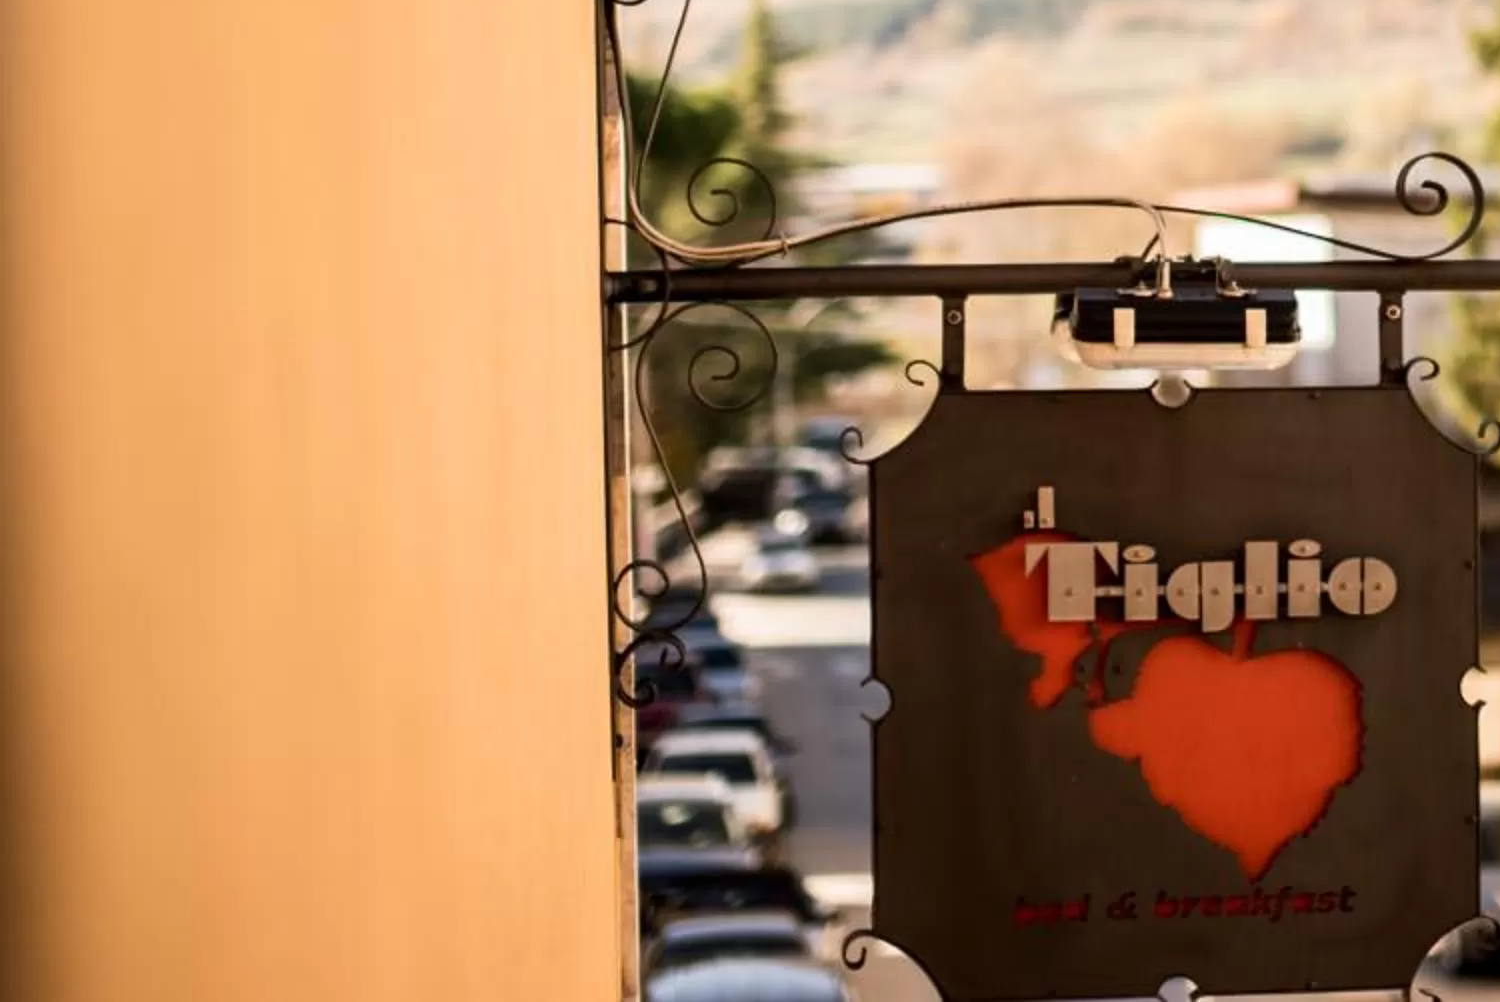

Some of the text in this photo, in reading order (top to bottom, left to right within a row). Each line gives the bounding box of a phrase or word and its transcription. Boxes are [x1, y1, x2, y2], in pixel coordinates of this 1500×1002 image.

[1024, 539, 1398, 632] Tiglio
[1013, 884, 1357, 926] bed & breakfast
